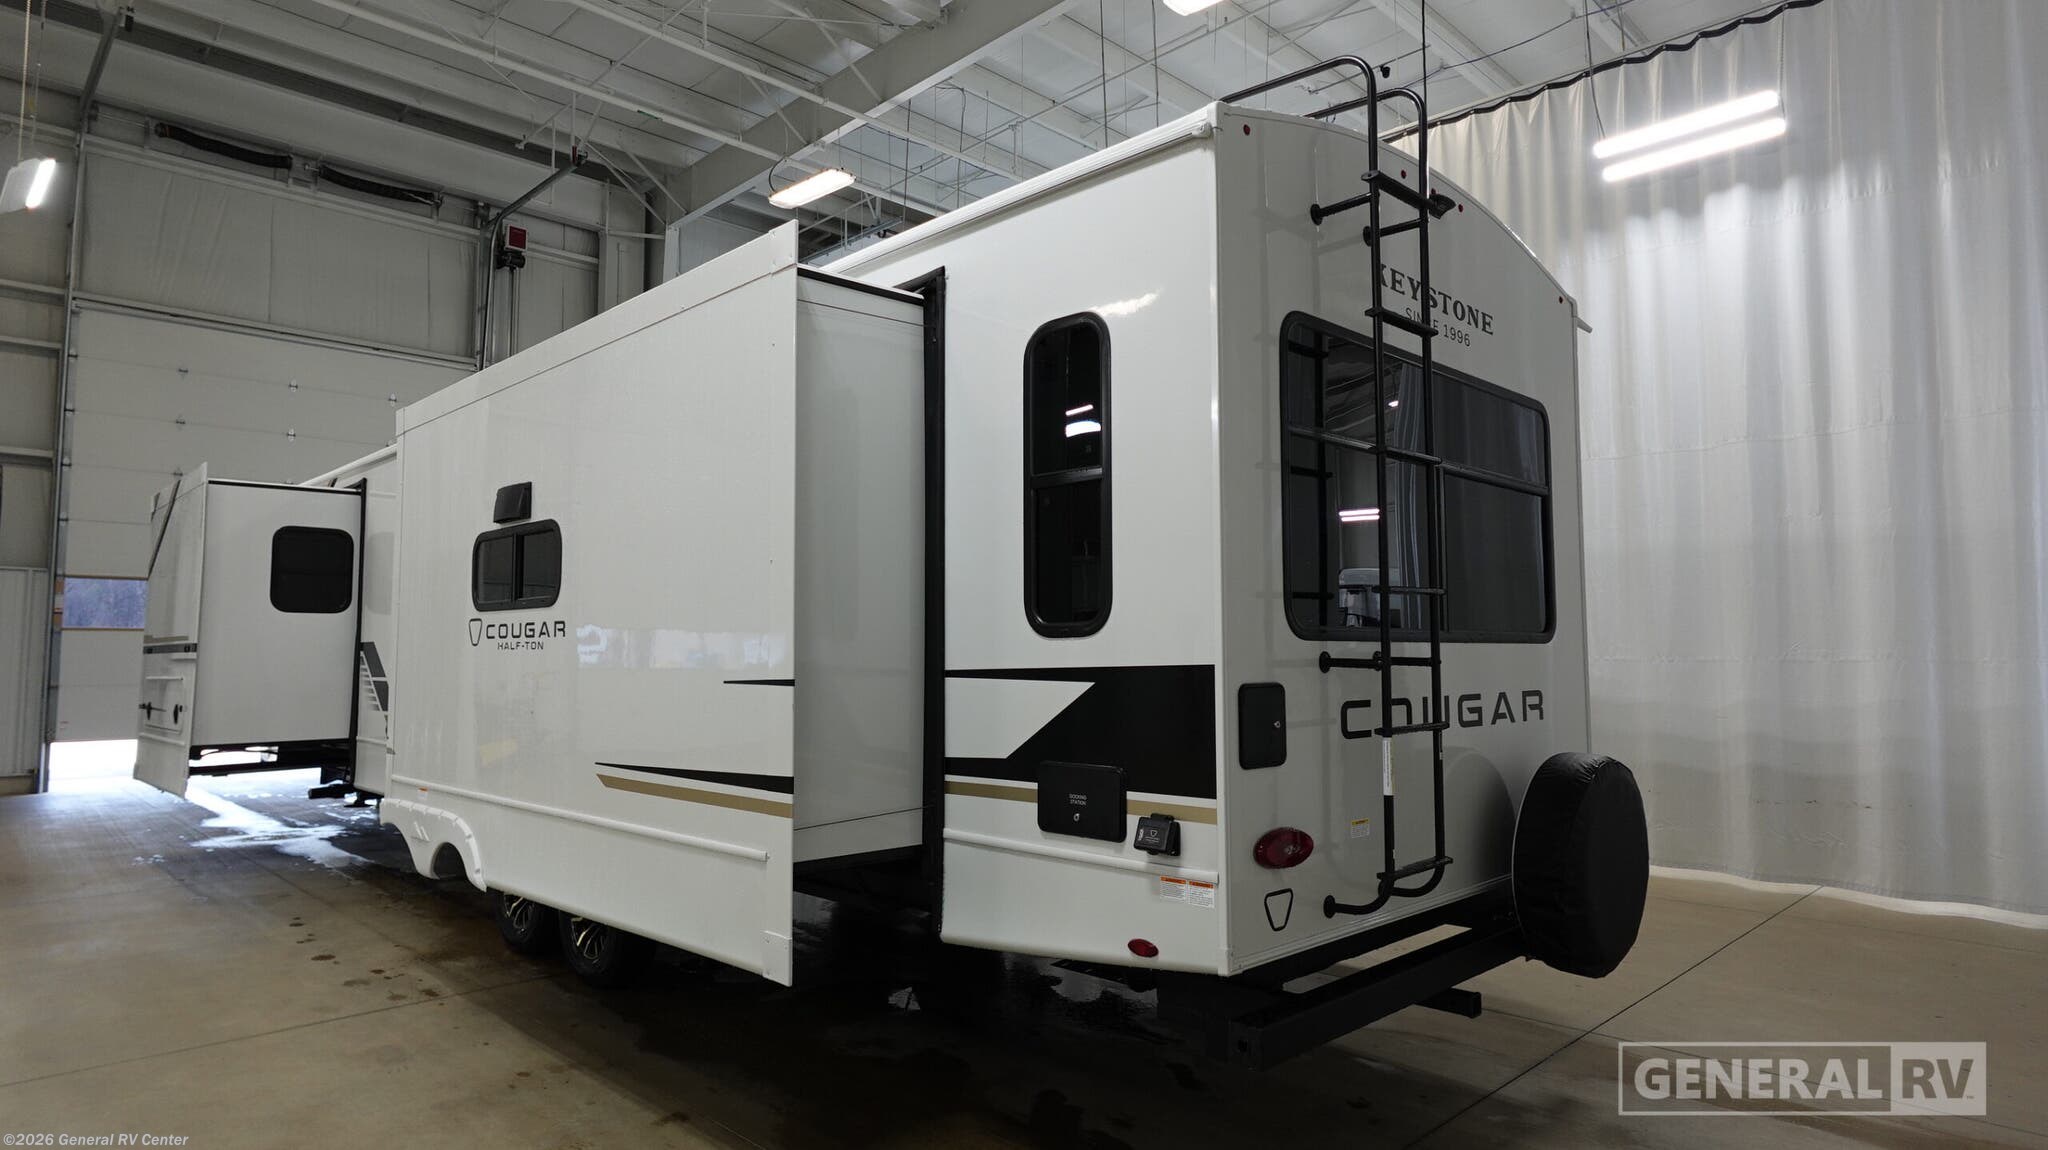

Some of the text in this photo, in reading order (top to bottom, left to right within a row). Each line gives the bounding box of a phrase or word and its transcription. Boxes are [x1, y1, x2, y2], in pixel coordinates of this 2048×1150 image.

[1405, 307, 1471, 347] SINE 1996
[486, 620, 567, 639] COUGAR
[497, 641, 545, 650] HALF-TON
